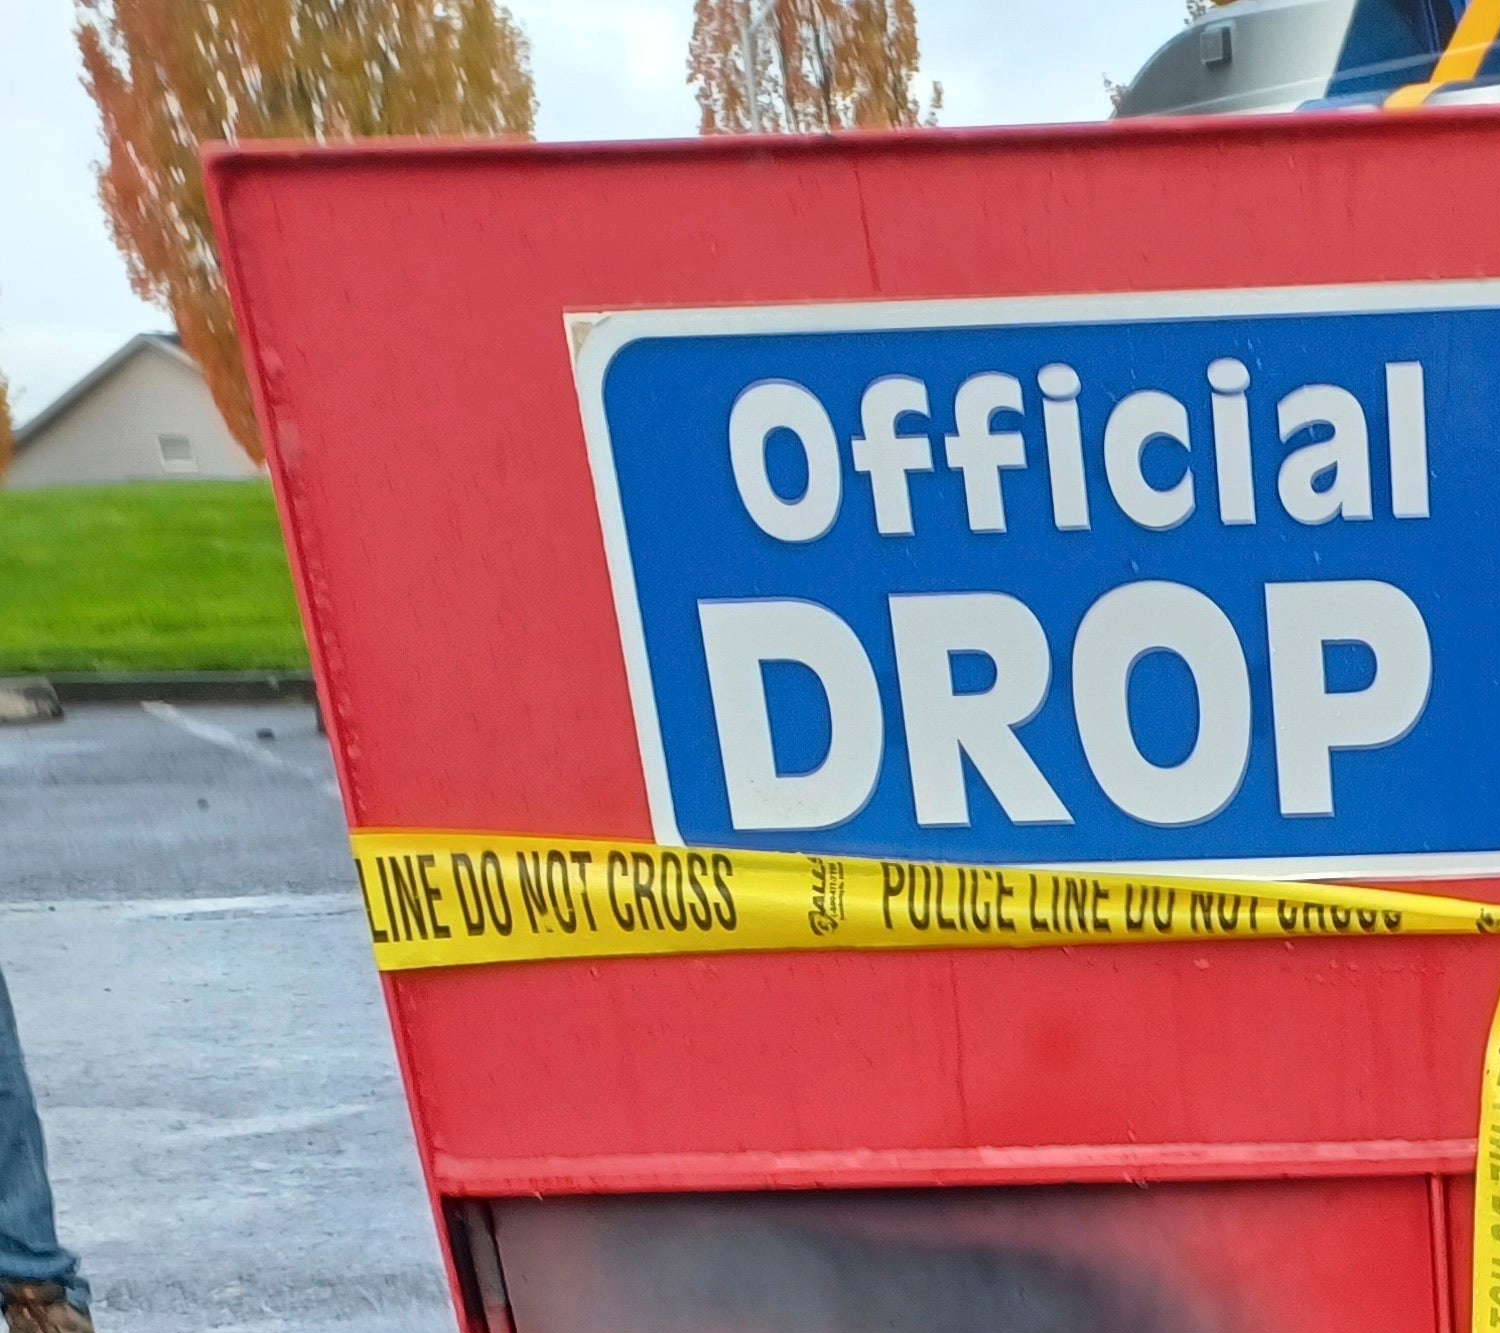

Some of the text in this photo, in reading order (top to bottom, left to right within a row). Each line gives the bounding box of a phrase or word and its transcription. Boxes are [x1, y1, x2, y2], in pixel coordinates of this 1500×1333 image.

[728, 358, 1430, 543] Official
[697, 579, 1433, 831] DROP
[354, 854, 451, 943] LINE
[451, 850, 512, 936] DO
[517, 850, 598, 934] NOT
[607, 851, 737, 931] CROSS
[880, 862, 1016, 931] POLICE
[1029, 873, 1112, 934] LINE
